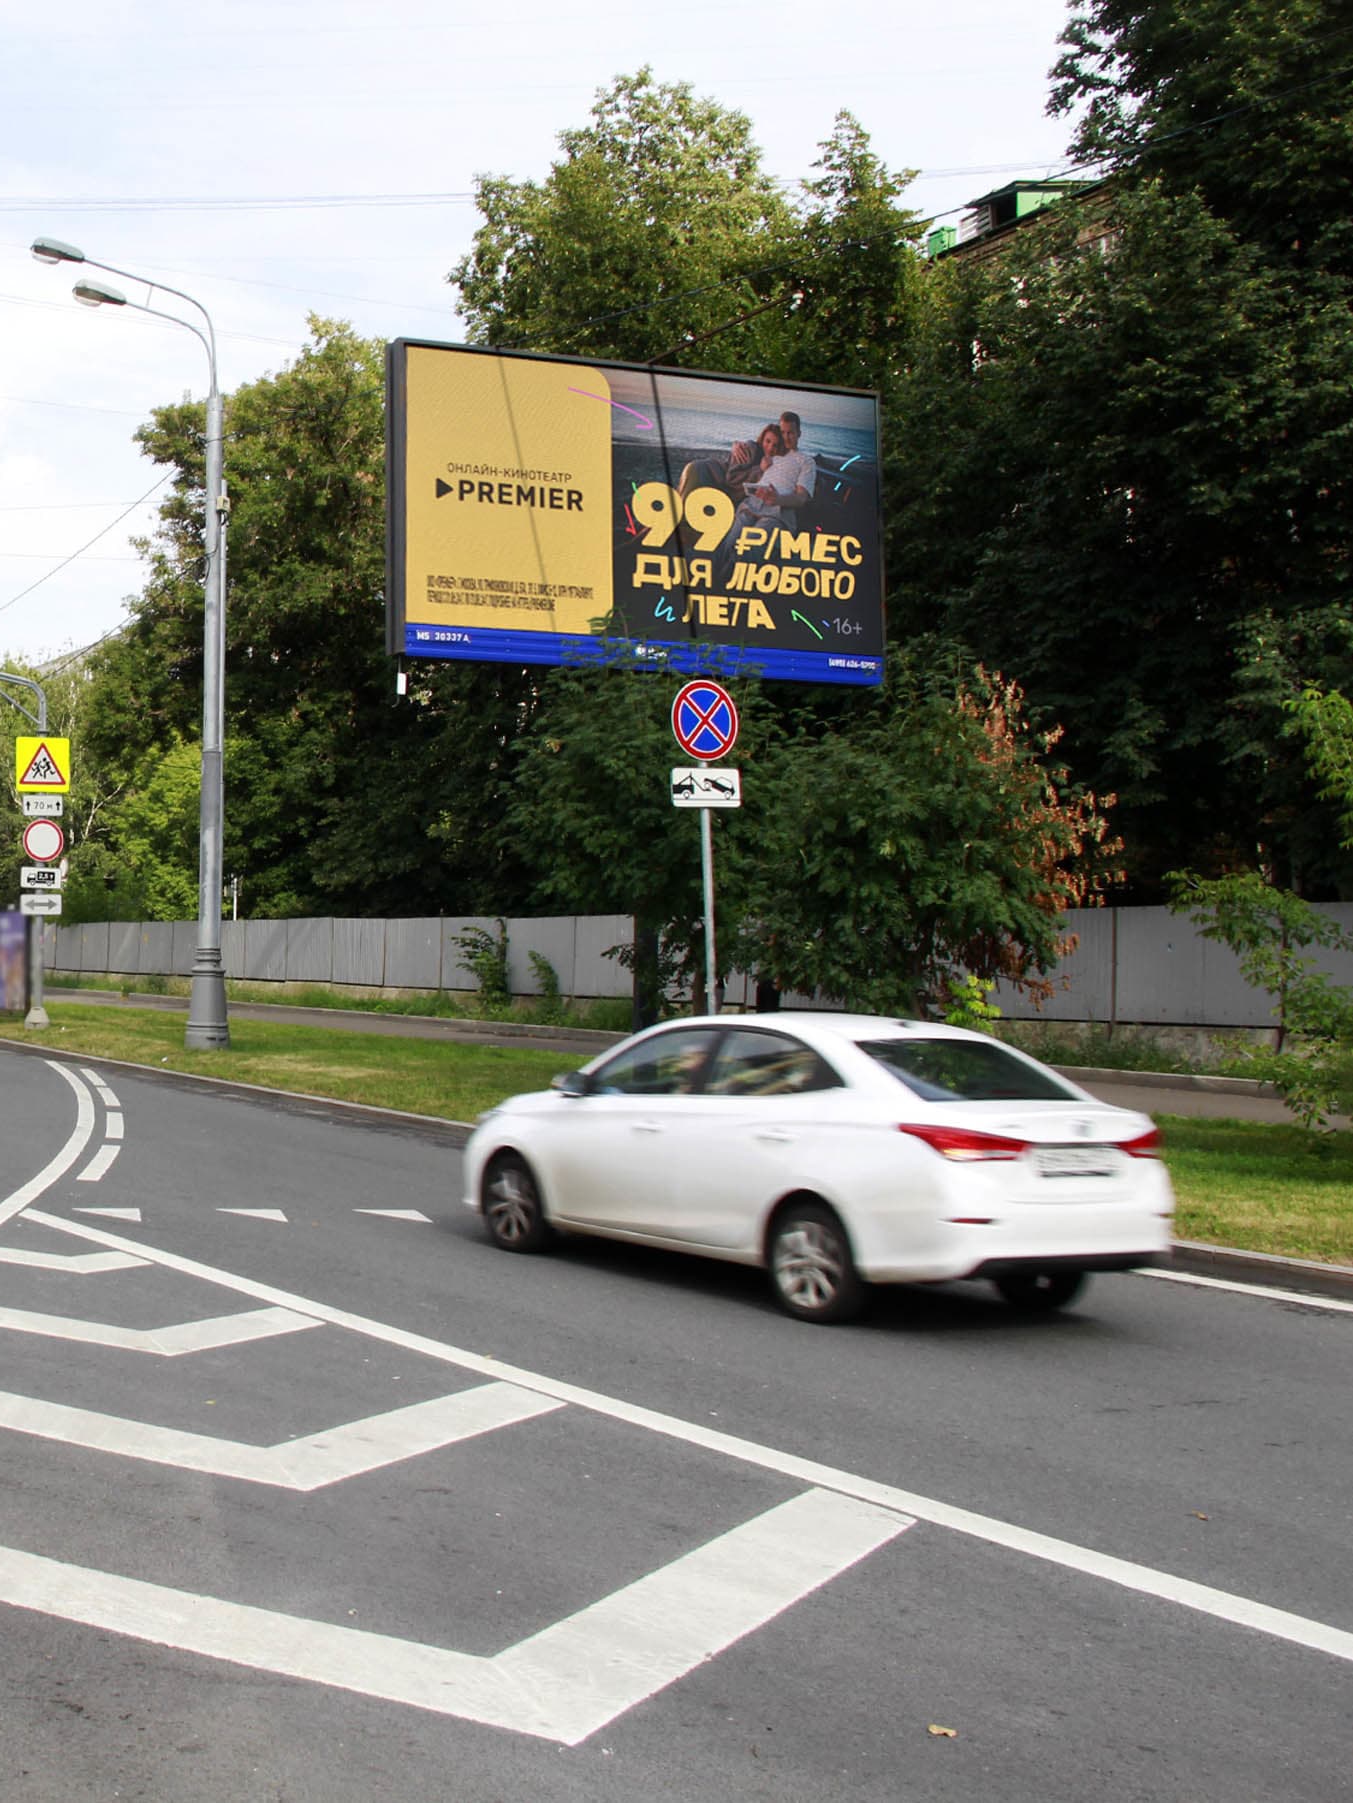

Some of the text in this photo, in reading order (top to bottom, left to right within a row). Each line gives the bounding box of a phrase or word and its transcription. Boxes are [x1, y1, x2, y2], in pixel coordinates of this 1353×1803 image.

[447, 462, 572, 483] ОНЛАЙН-КИНОТЕАТР
[458, 479, 584, 512] PREMIER
[632, 481, 735, 552] 99
[632, 553, 713, 591] ДЛЯ
[725, 561, 856, 600] ЛЮБОГО
[681, 593, 777, 630] ЛЕТА
[832, 617, 863, 635] 16+
[34, 801, 45, 810] 70
